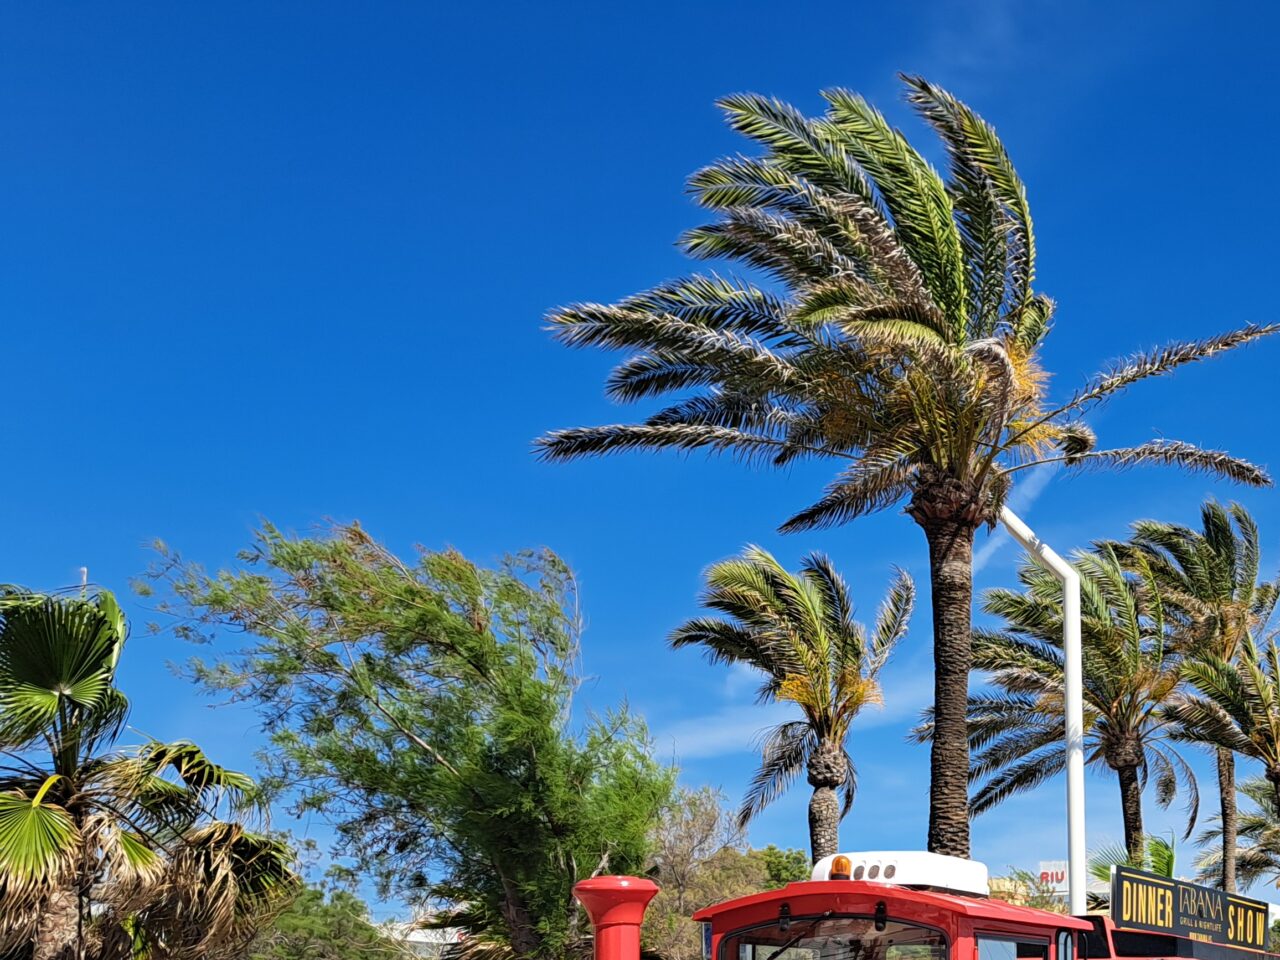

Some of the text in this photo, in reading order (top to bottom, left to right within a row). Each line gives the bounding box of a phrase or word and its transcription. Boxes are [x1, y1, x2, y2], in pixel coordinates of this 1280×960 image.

[1040, 870, 1065, 884] RIU
[1122, 880, 1173, 928] DINNER
[1177, 884, 1223, 921] TABANA
[1179, 916, 1194, 927] GRILL
[1199, 919, 1222, 932] NIGHTLIFE
[1227, 904, 1265, 946] SHOW
